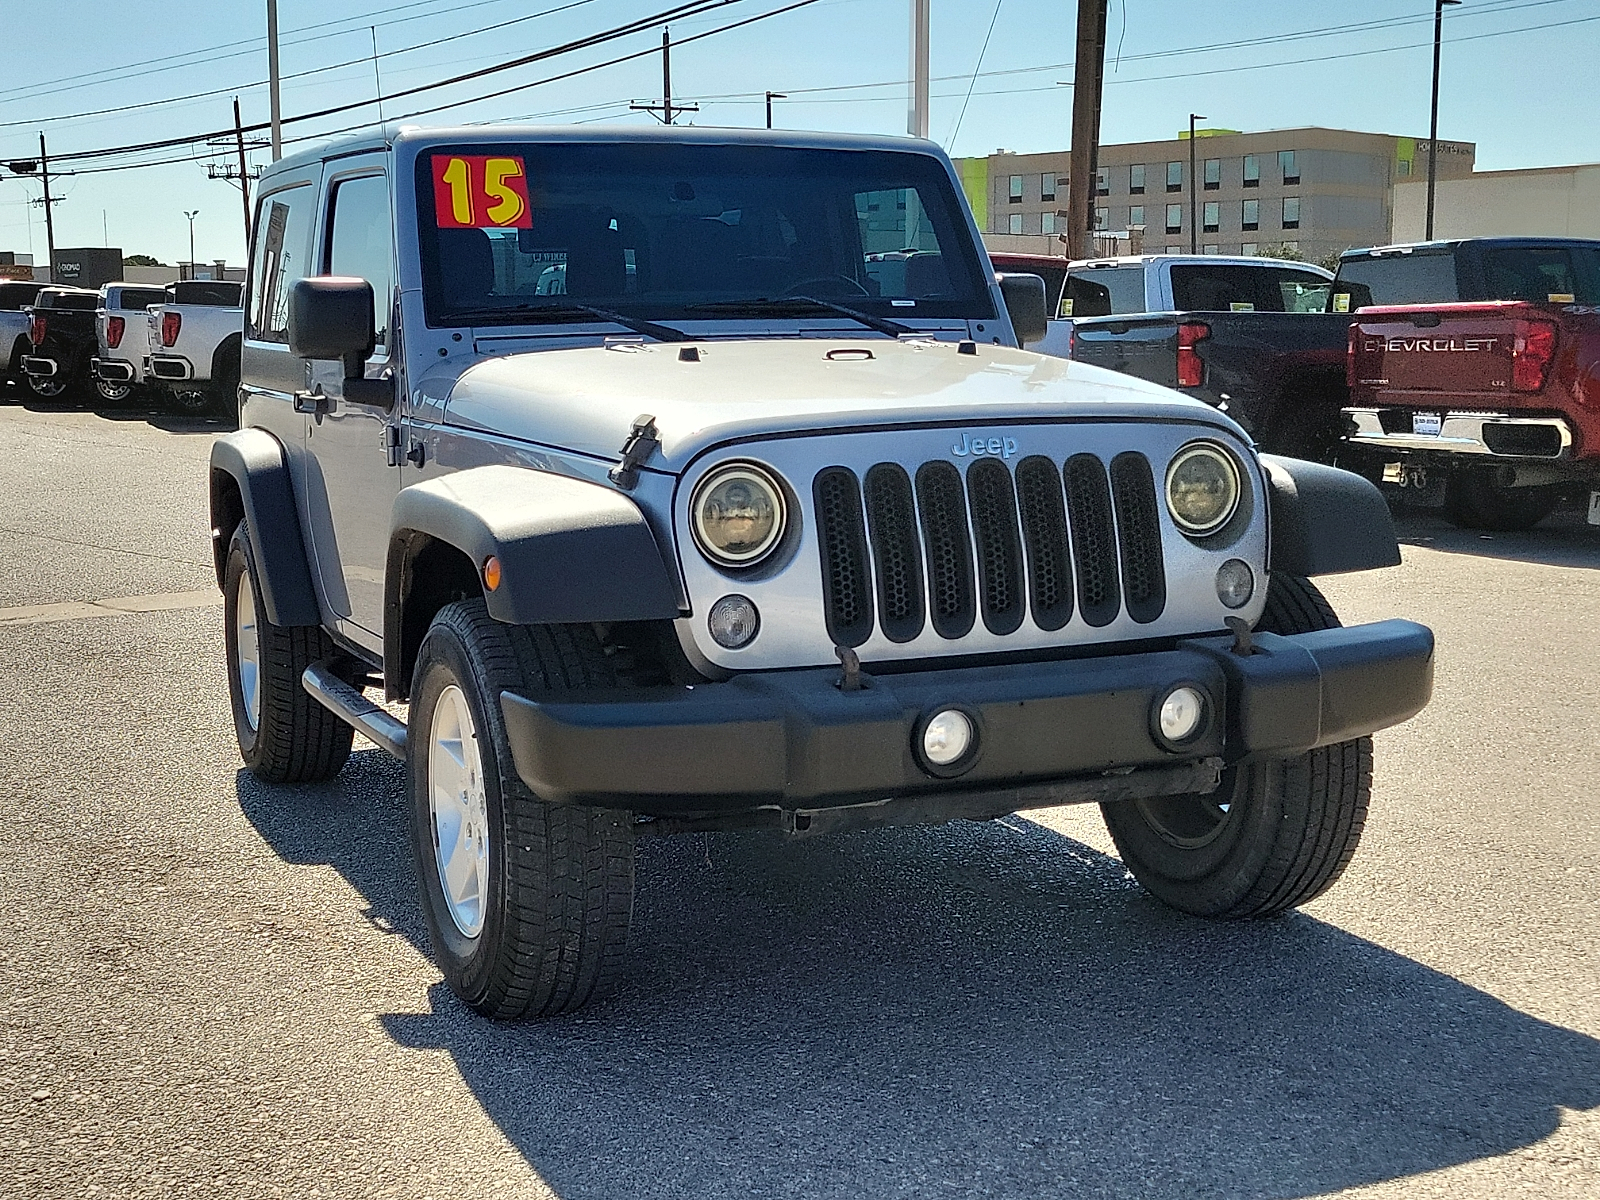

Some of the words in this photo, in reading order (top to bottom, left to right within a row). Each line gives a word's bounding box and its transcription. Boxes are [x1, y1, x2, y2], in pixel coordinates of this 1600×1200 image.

[443, 158, 524, 226] 15
[1365, 339, 1497, 352] CHEVROLET
[952, 433, 1018, 458] Jeep
